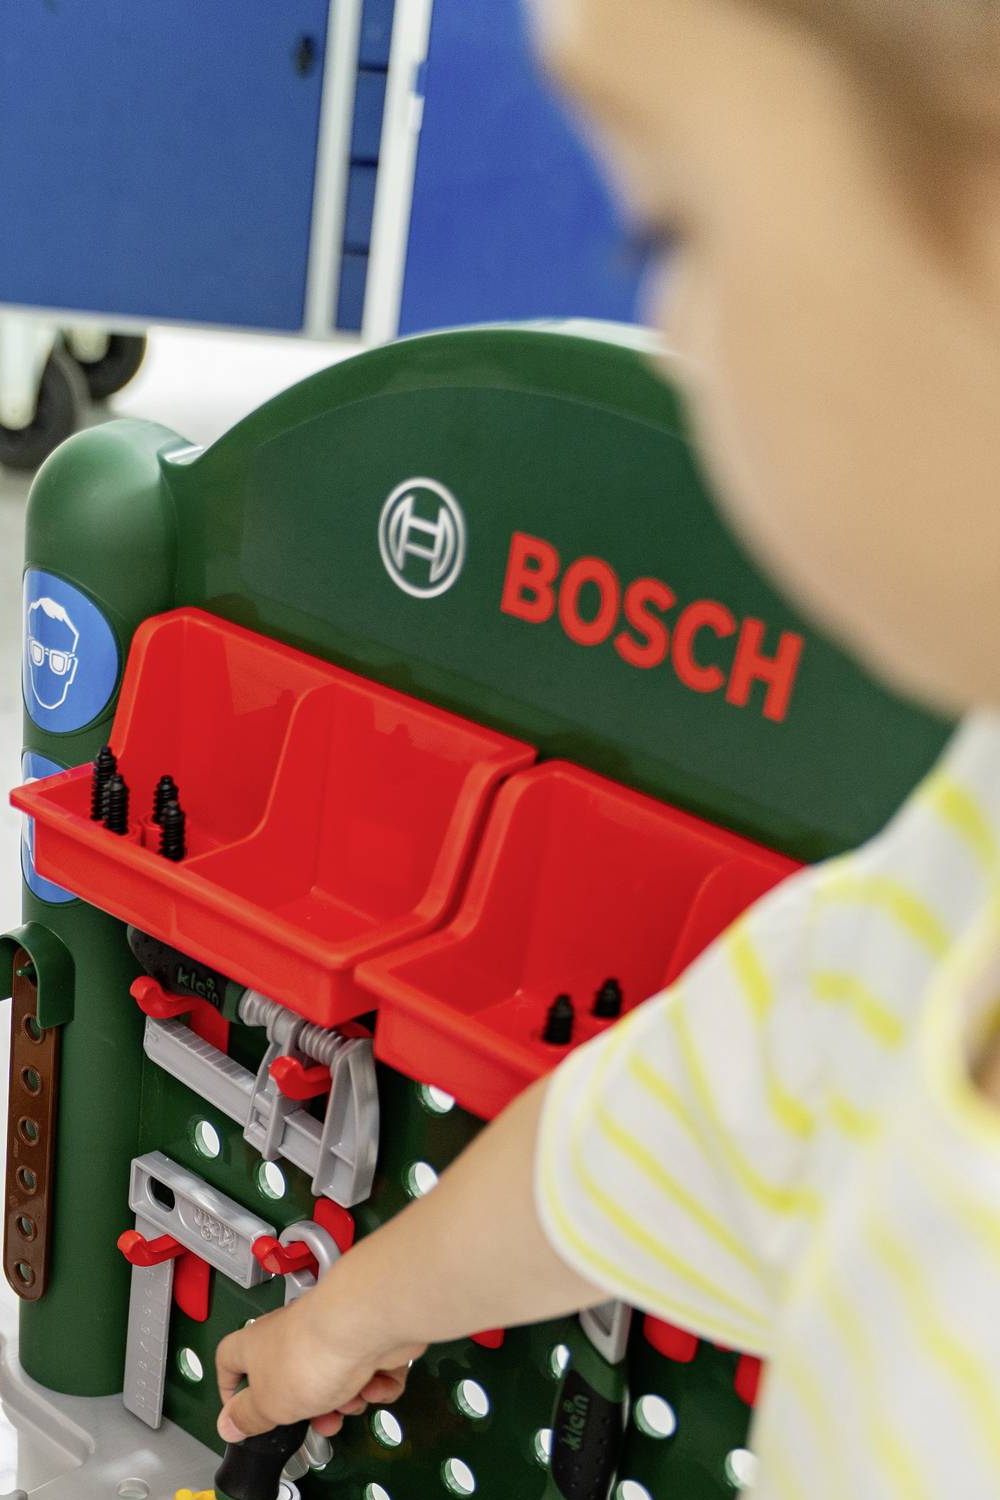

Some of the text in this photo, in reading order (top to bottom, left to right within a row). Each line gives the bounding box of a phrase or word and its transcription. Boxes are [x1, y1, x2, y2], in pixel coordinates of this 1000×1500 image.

[501, 530, 803, 723] BOSCH
[177, 966, 219, 1007] klein
[562, 1394, 590, 1451] klein
